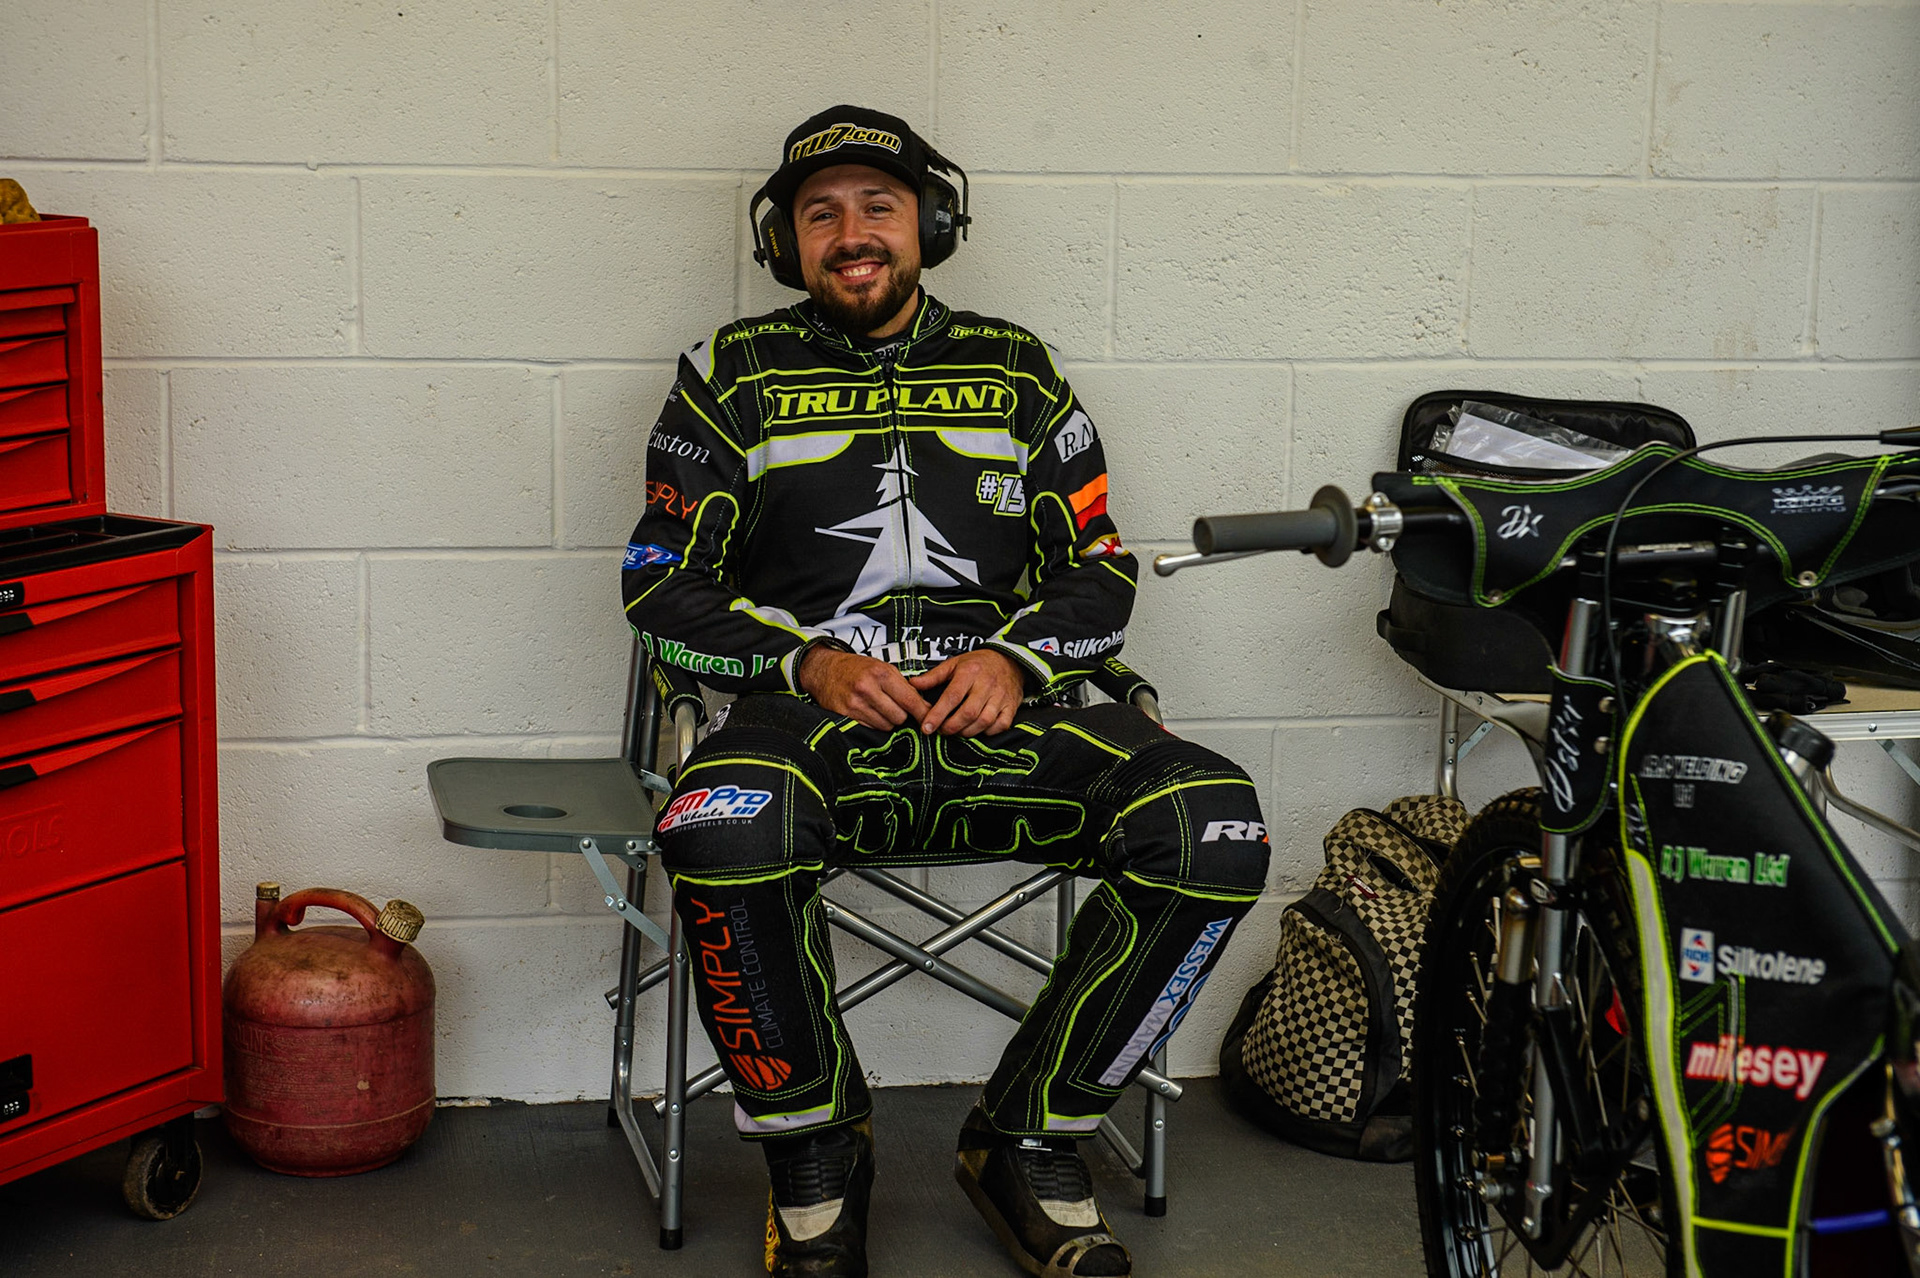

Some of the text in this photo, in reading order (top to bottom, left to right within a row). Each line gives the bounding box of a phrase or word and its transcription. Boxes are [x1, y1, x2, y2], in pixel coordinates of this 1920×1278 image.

[768, 227, 780, 258] STANLEY
[953, 326, 1032, 343] TRU PLANT
[777, 385, 1007, 417] TRU PLANT
[657, 637, 745, 678] Warren
[680, 808, 725, 823] Wheels
[1686, 847, 1750, 883] Warren
[1753, 852, 1791, 888] Ltd
[690, 897, 762, 1050] SIMPLY
[730, 897, 785, 1050] CLIMATE CONTROL
[1716, 945, 1827, 985] Silkolene
[1102, 917, 1233, 1085] WESSEX MARINE
